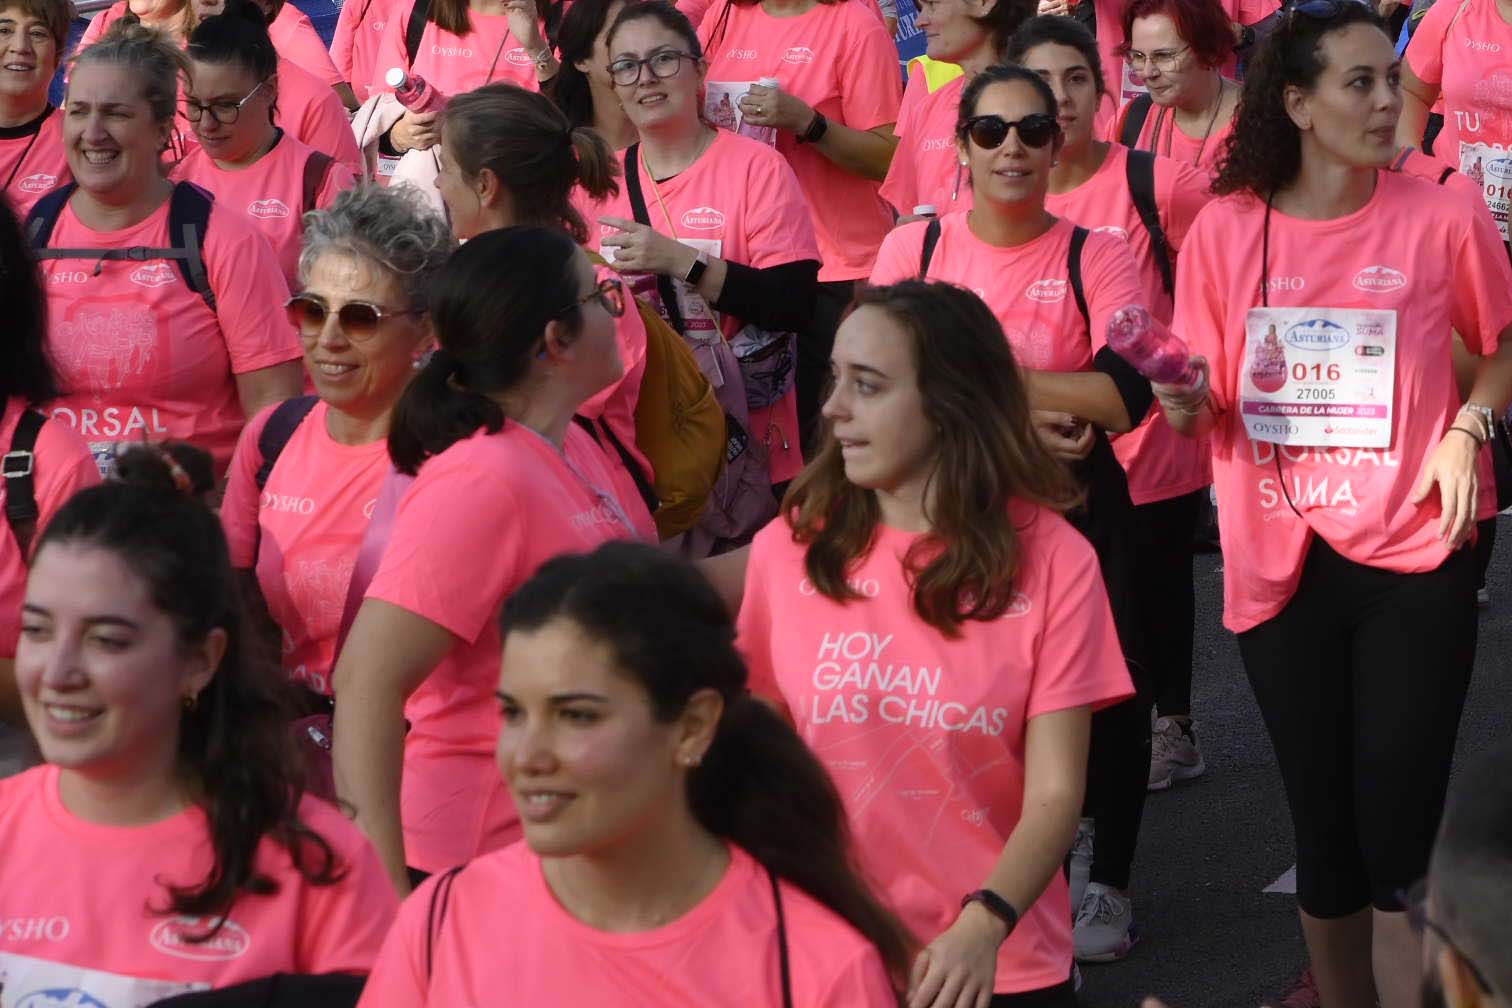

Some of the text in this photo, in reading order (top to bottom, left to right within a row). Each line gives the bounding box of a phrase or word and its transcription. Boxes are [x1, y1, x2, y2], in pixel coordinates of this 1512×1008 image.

[1454, 111, 1480, 132] TU
[1356, 276, 1403, 287] ASTURIANA
[1288, 328, 1347, 343] ASTURIANA
[1292, 362, 1341, 382] 016
[1297, 388, 1336, 400] 27005
[1258, 405, 1298, 415] CARRERA
[1301, 405, 1313, 414] DE
[1314, 405, 1326, 415] LA
[1327, 406, 1354, 415] MUJER
[1253, 423, 1299, 435] OYSHO
[1259, 476, 1358, 510] SUMA
[817, 631, 894, 660] HOY
[812, 661, 942, 696] GANAN
[811, 694, 1009, 737] LAS CHICAS
